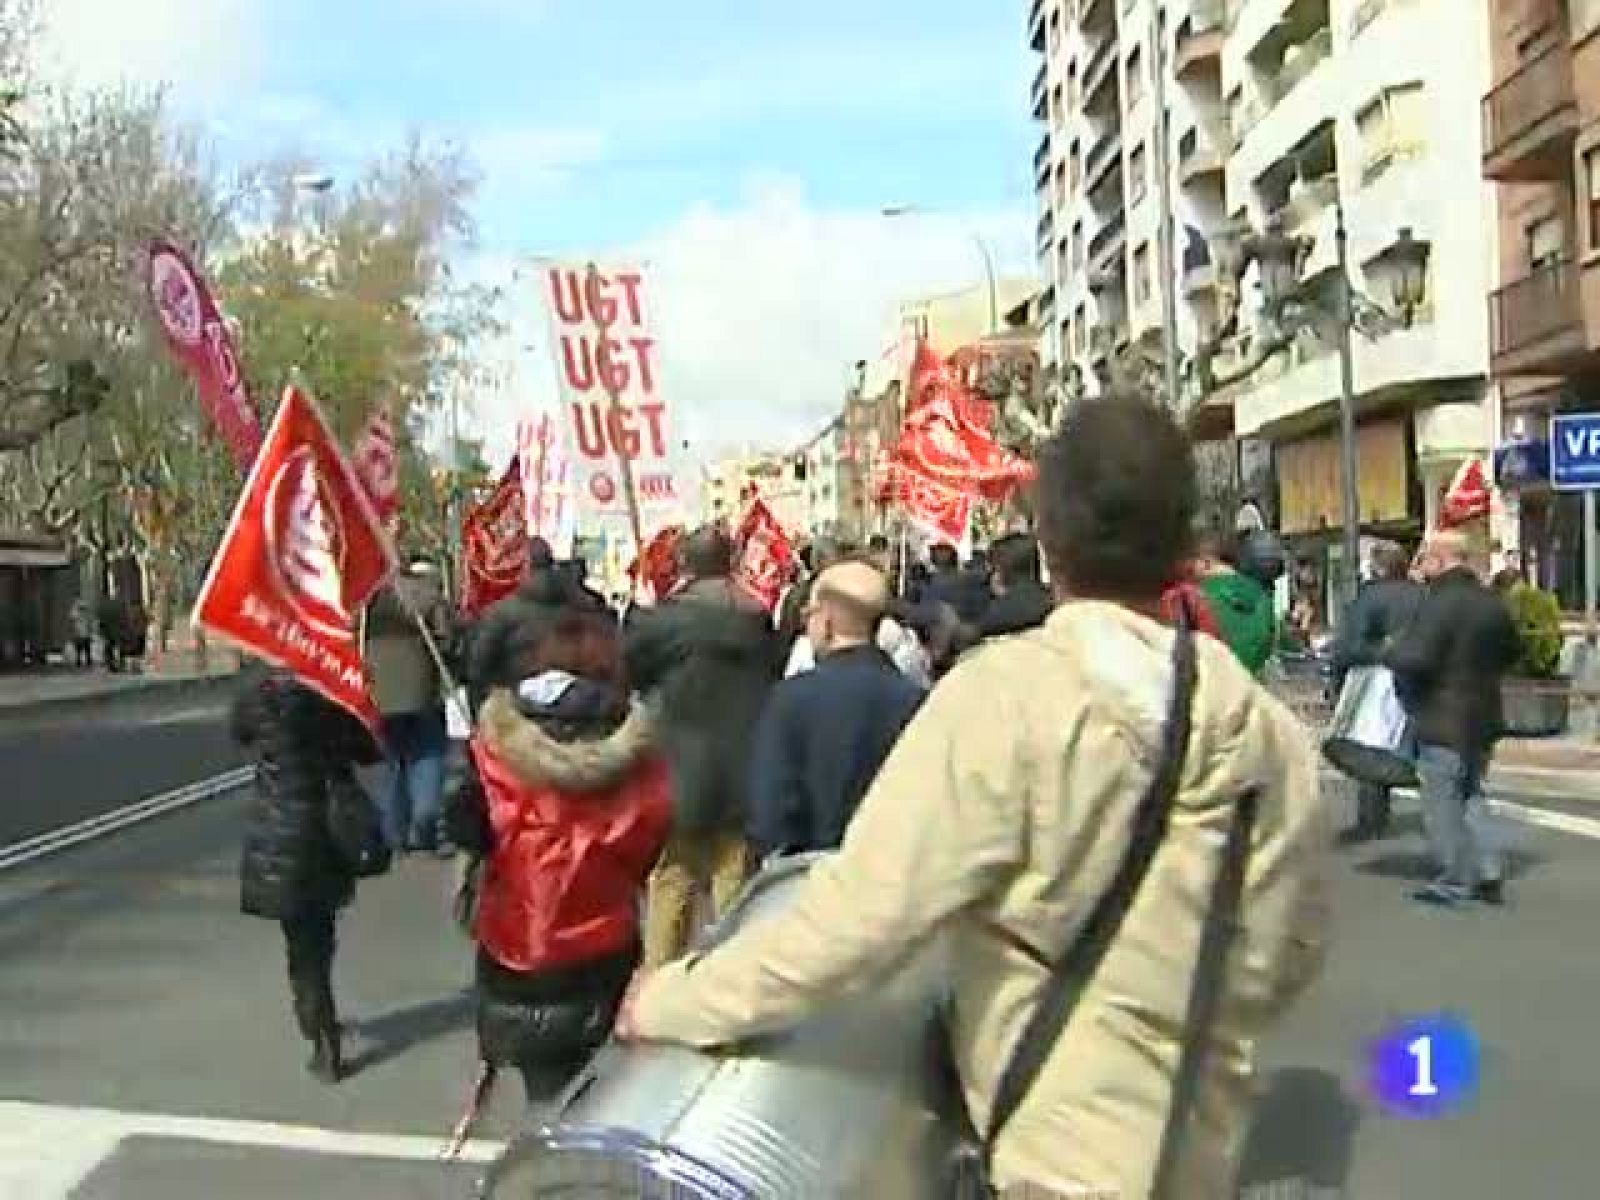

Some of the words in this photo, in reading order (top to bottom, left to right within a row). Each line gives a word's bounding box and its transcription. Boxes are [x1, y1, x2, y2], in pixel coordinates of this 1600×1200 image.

[549, 269, 641, 326] UGT
[562, 336, 654, 392] UGT
[571, 402, 666, 459] UGT
